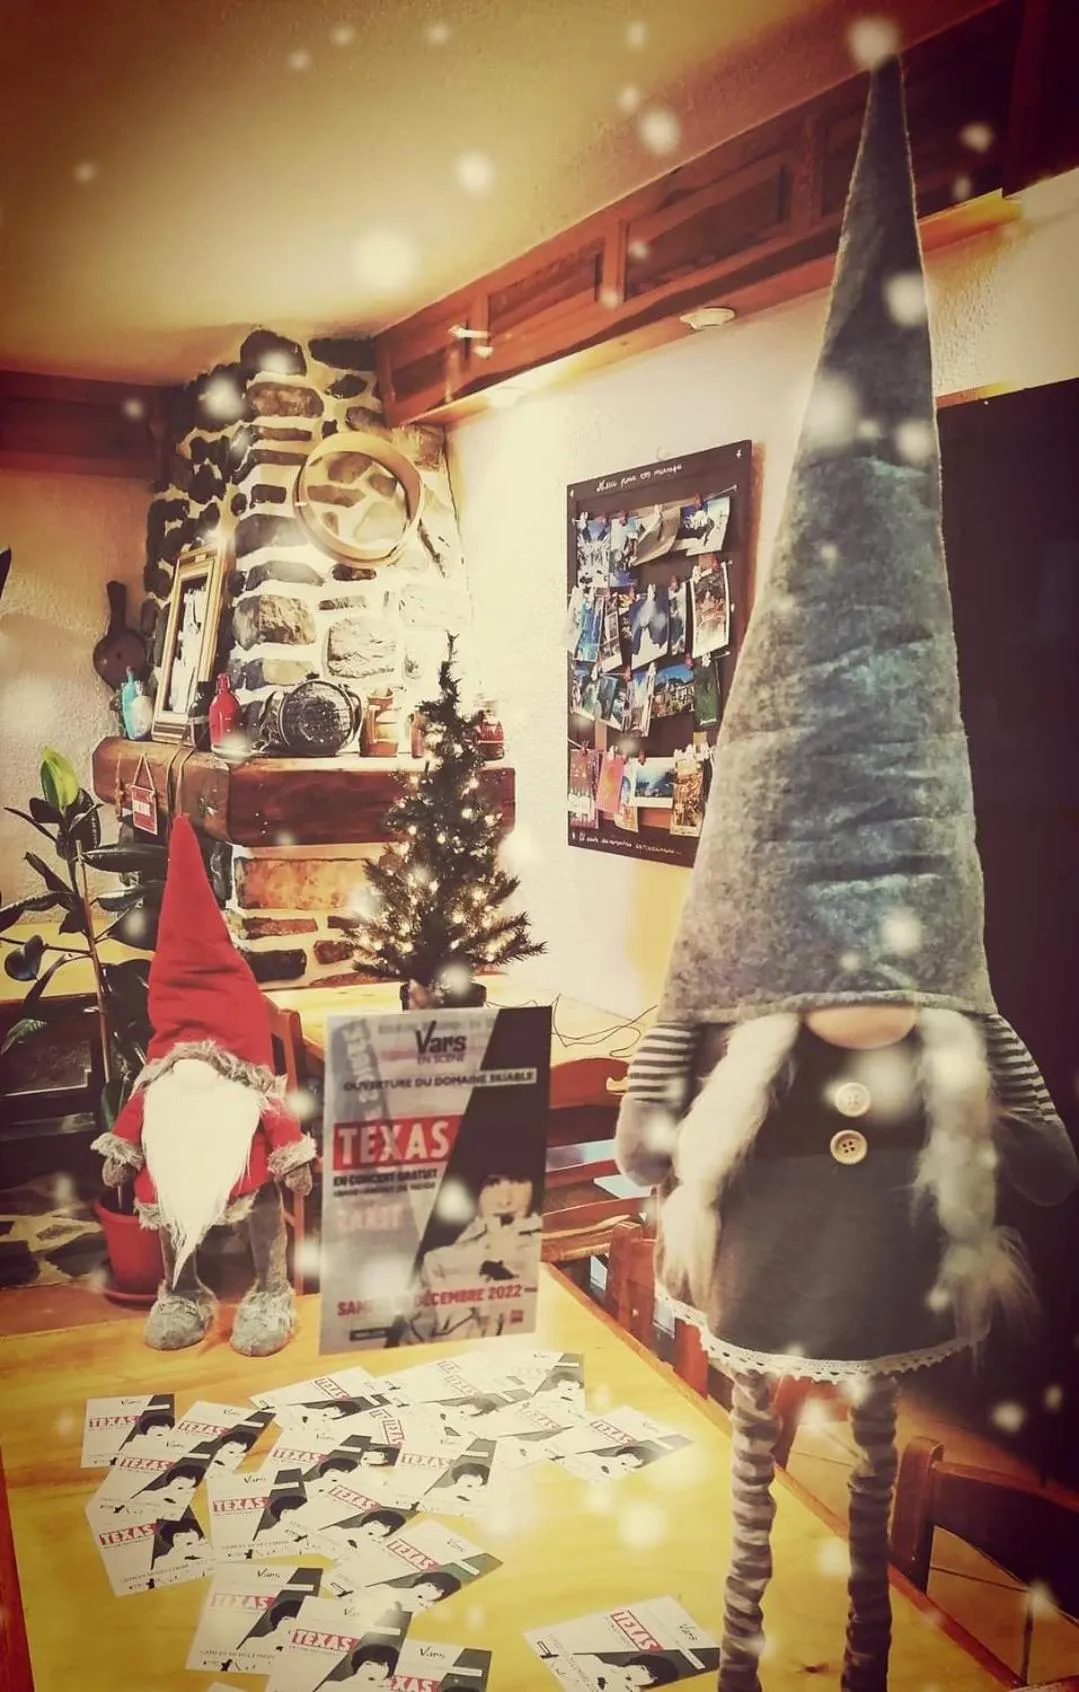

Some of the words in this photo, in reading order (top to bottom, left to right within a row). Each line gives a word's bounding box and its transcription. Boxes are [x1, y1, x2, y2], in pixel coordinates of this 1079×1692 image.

[415, 1020, 467, 1054] Vars
[343, 1077, 412, 1091] OUVERTURE
[414, 1077, 433, 1088] DU
[434, 1074, 488, 1087] DOMAINE
[489, 1069, 534, 1082] SKIABLE
[338, 1121, 450, 1166] TEXAS
[333, 1176, 347, 1187] EN
[348, 1172, 396, 1185] CONCERT
[397, 1168, 437, 1181] GRATUIT
[487, 1284, 521, 1299] 2022
[89, 1416, 136, 1428] TEXAS
[178, 1422, 225, 1437] TEXAS
[119, 1458, 170, 1471] TEXAS
[273, 1450, 321, 1463] TEXAS
[214, 1497, 266, 1513] TEXAS
[331, 1486, 379, 1511] TEXAS
[99, 1526, 154, 1546] TEXAS
[389, 1542, 436, 1571] TEXAS
[212, 1594, 269, 1609] TEXAS
[294, 1630, 353, 1650] TEXAS
